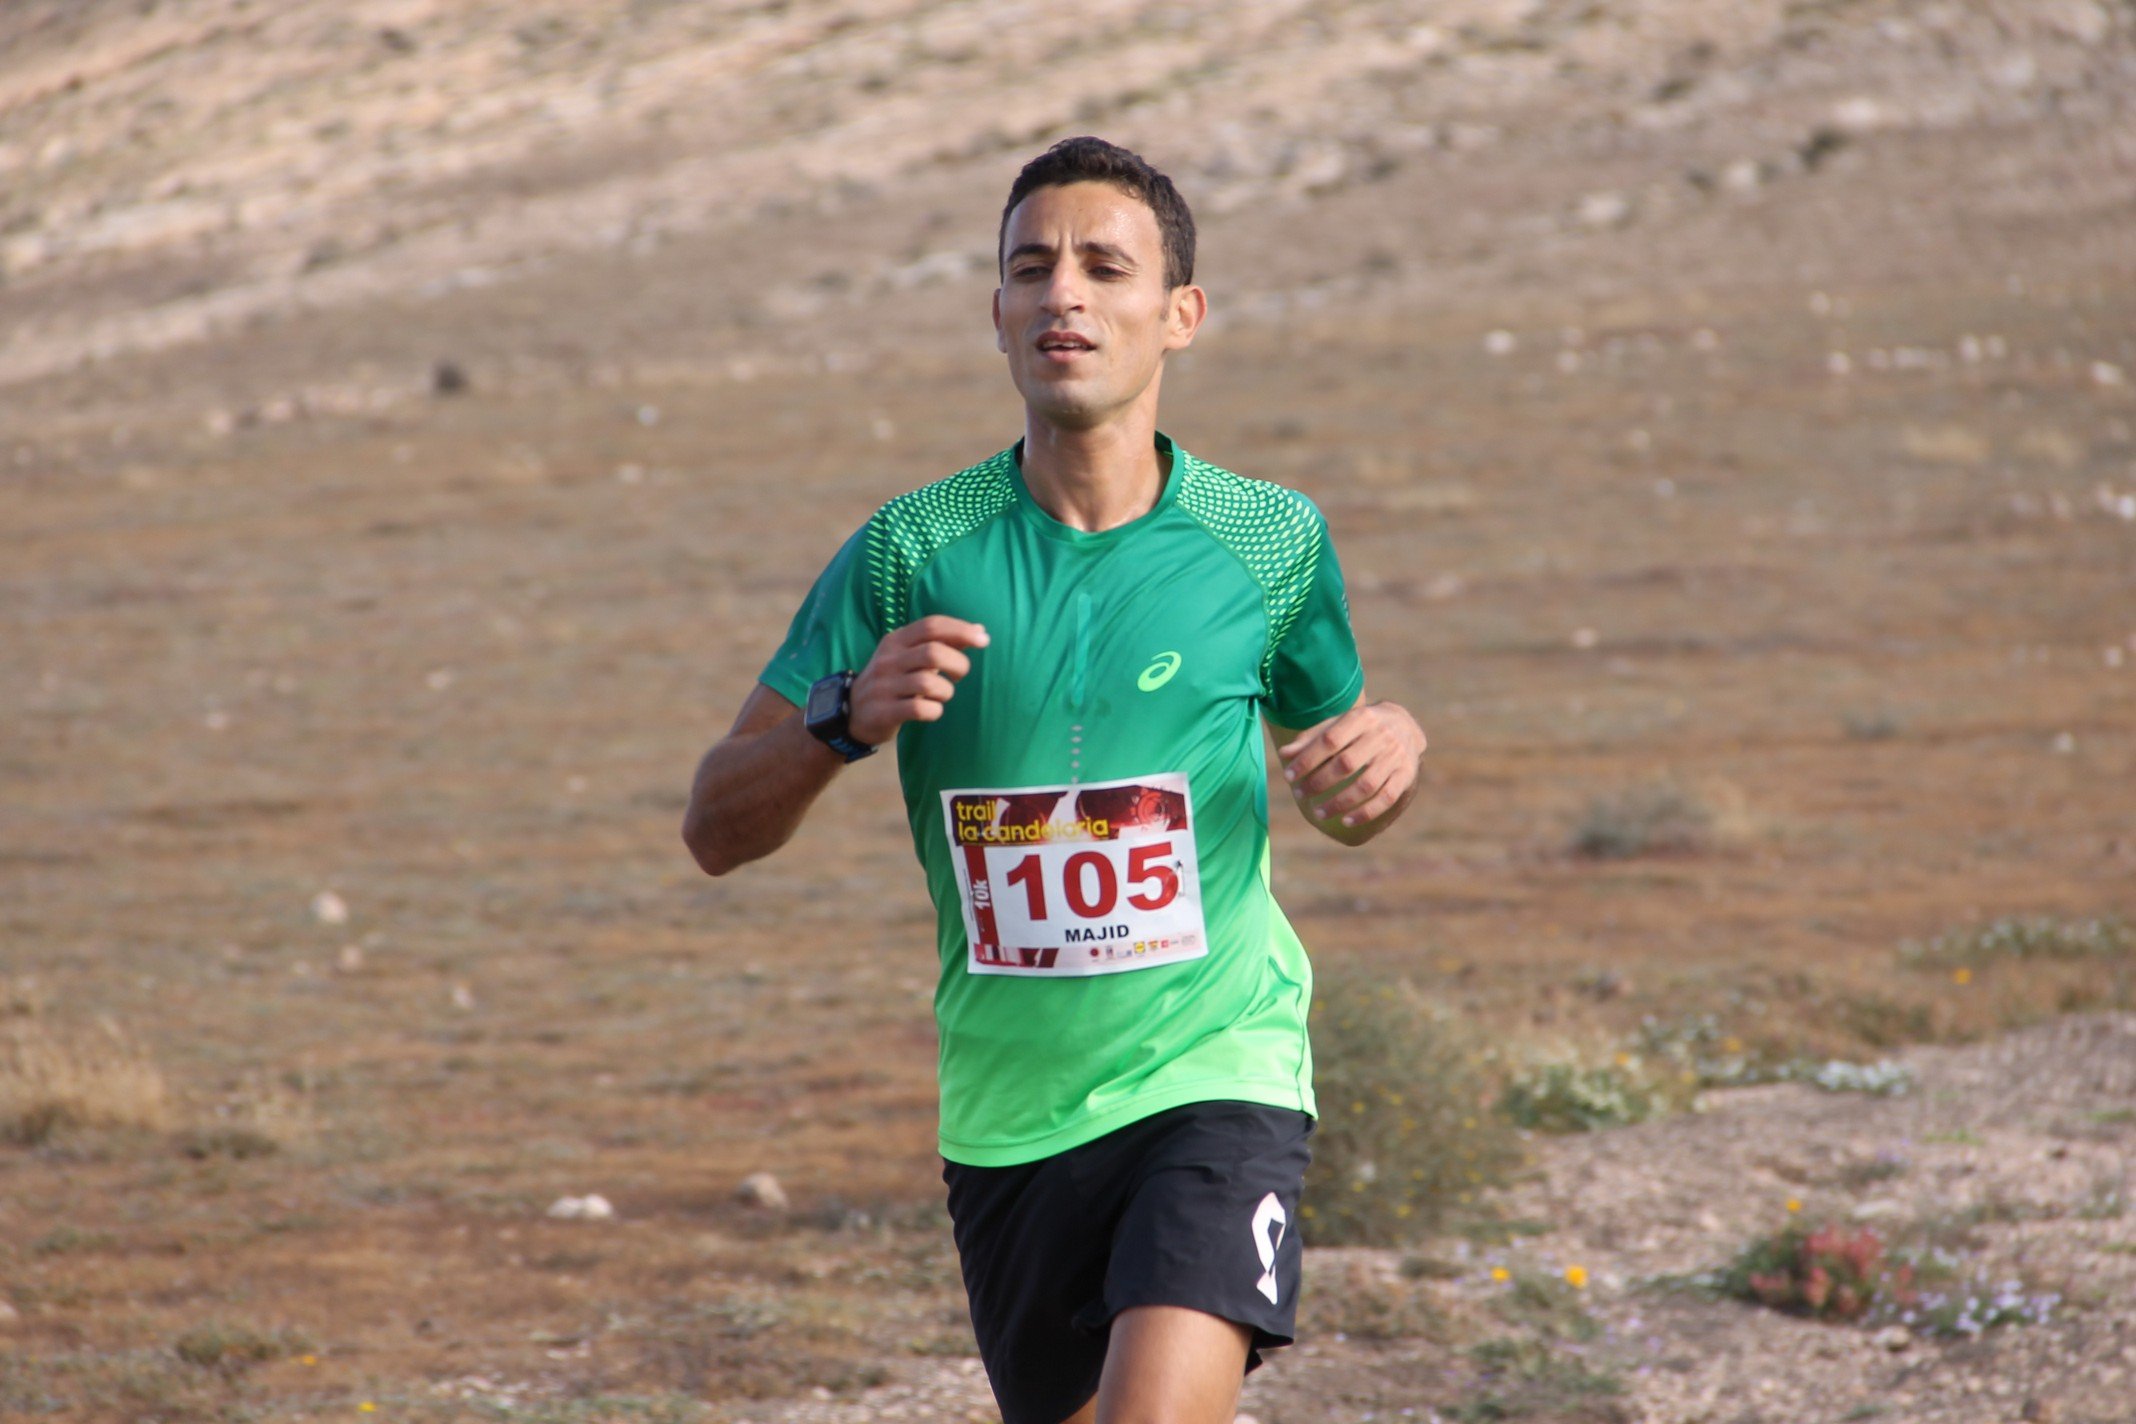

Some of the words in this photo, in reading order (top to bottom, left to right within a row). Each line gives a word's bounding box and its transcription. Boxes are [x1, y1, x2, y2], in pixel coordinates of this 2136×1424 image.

[956, 801, 996, 821] trail
[983, 816, 1109, 842] candelaria
[1006, 841, 1179, 920] 105
[1065, 925, 1129, 943] MAJID
